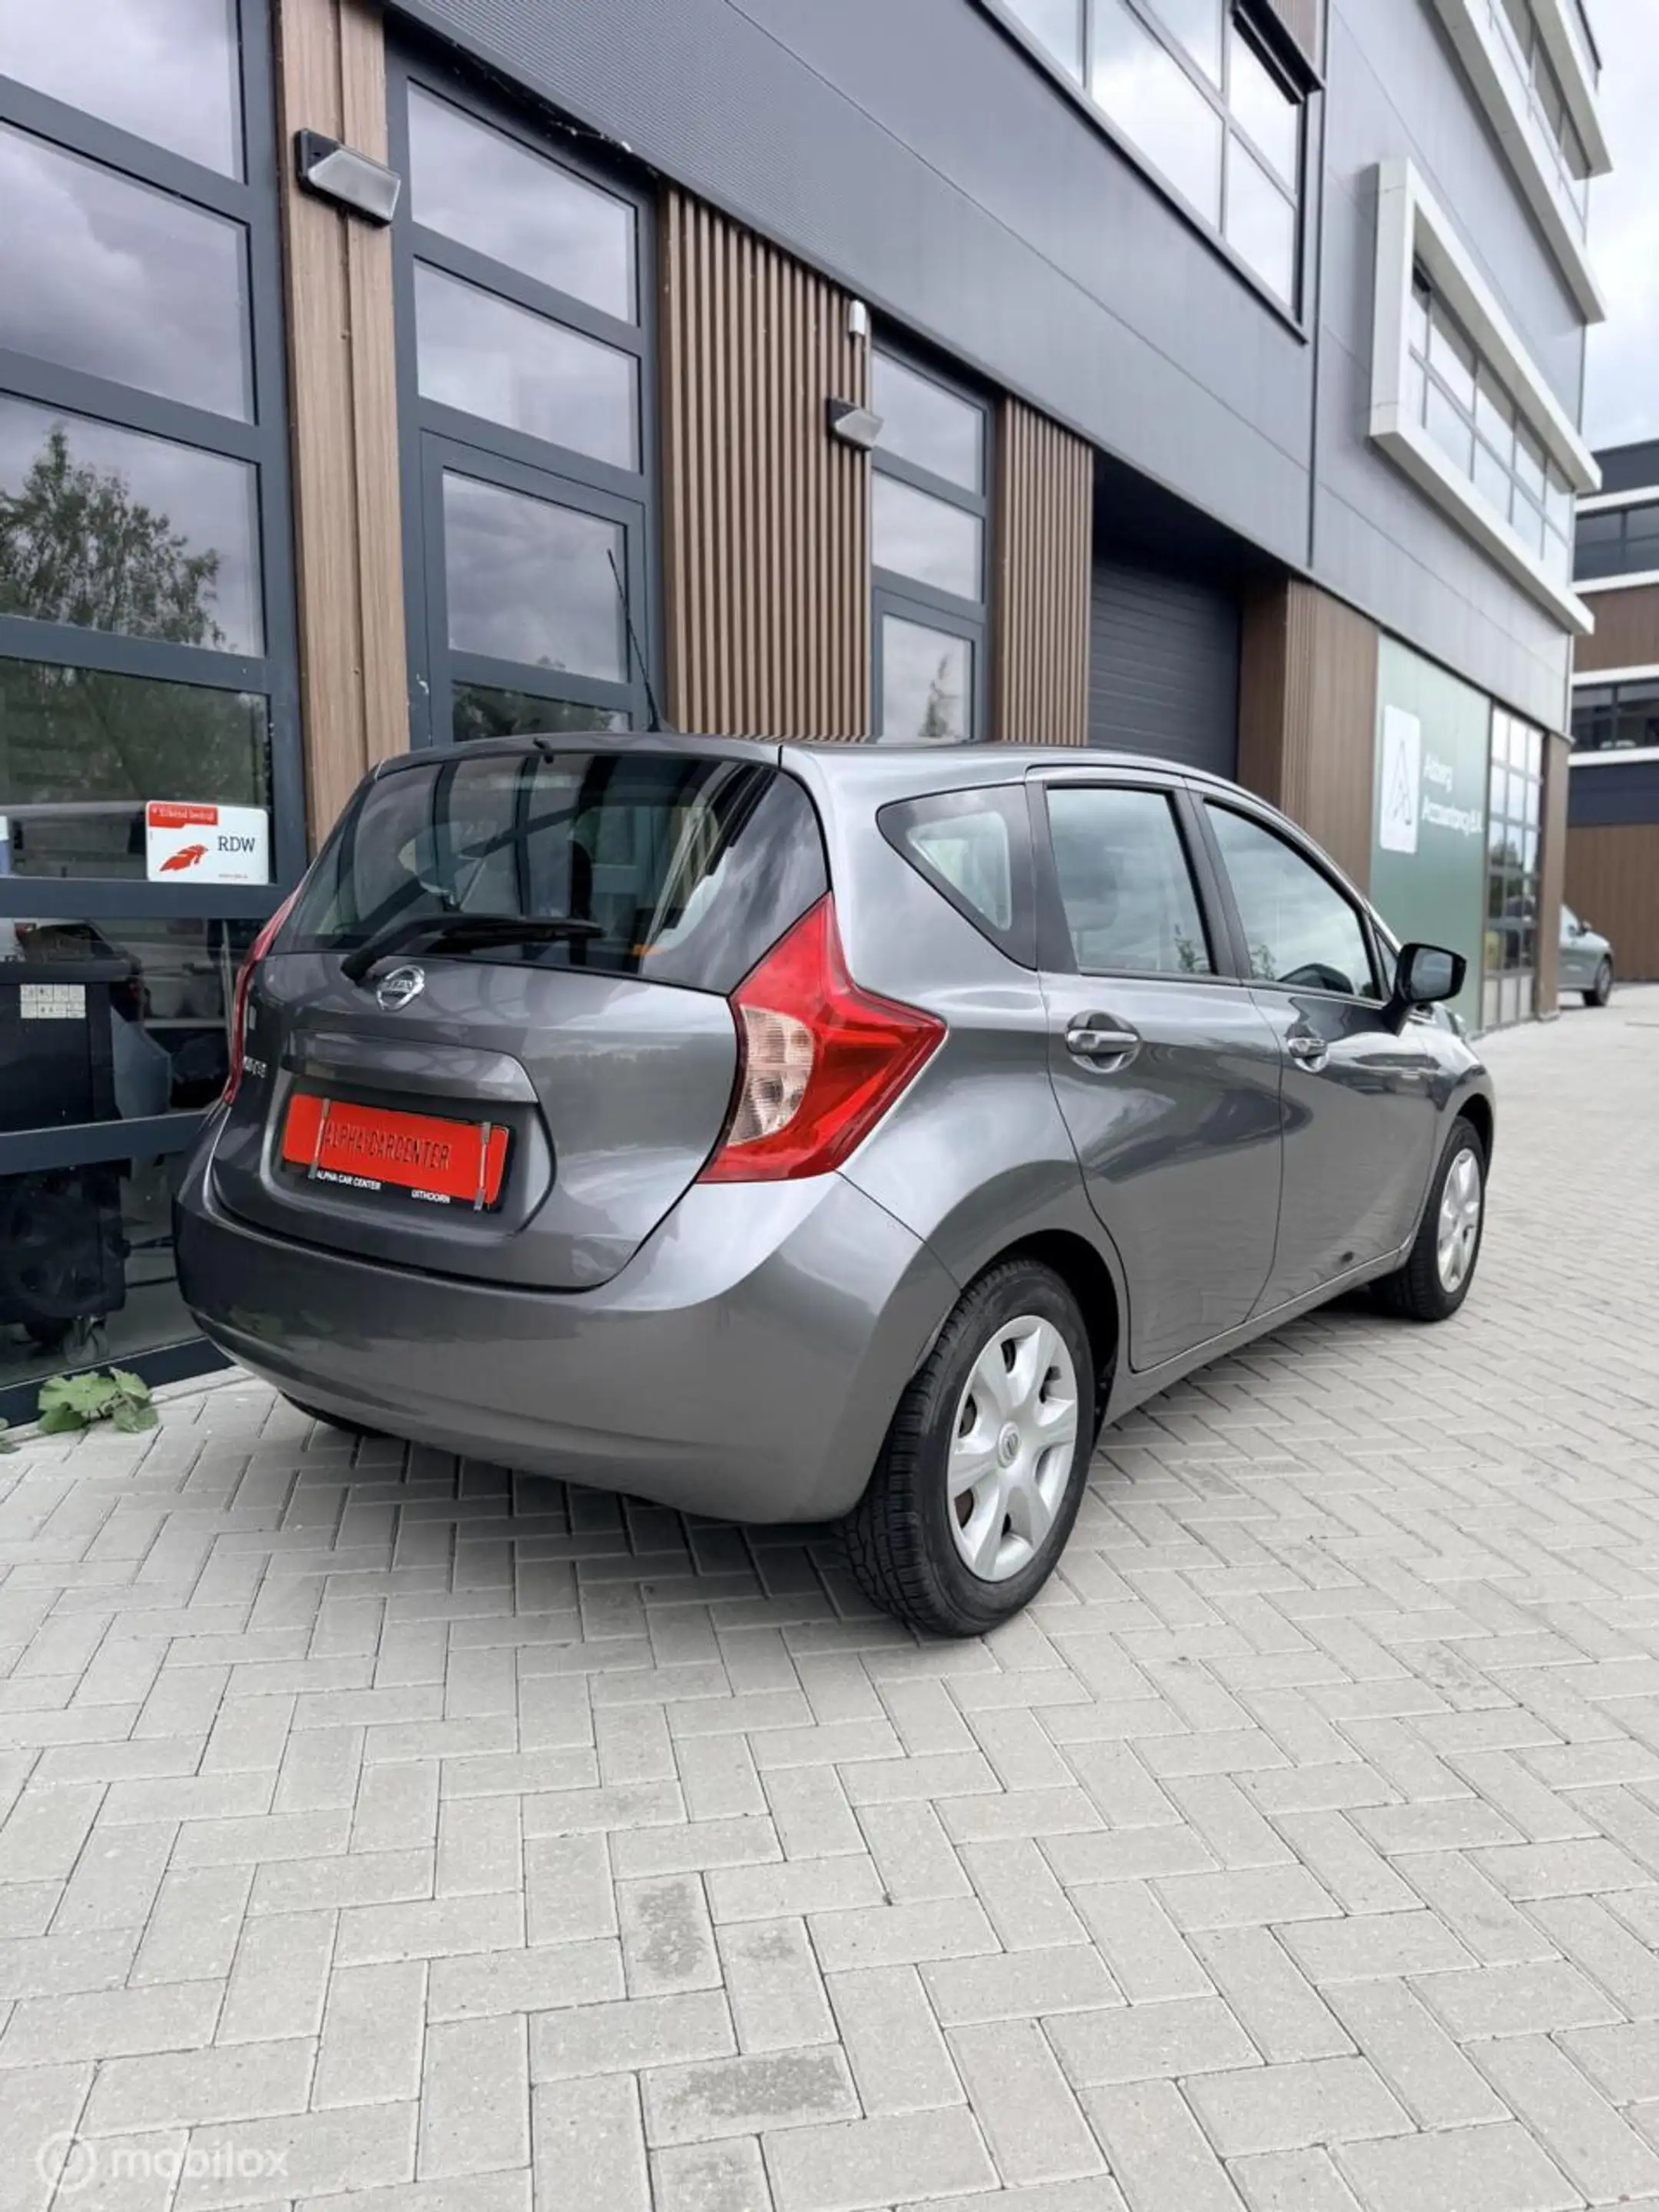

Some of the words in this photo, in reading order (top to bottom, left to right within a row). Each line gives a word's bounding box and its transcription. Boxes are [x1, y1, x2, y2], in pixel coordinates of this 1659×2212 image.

[217, 836, 256, 853] RDW
[338, 1174, 353, 1186] CAR
[353, 1177, 382, 1190] CENTER
